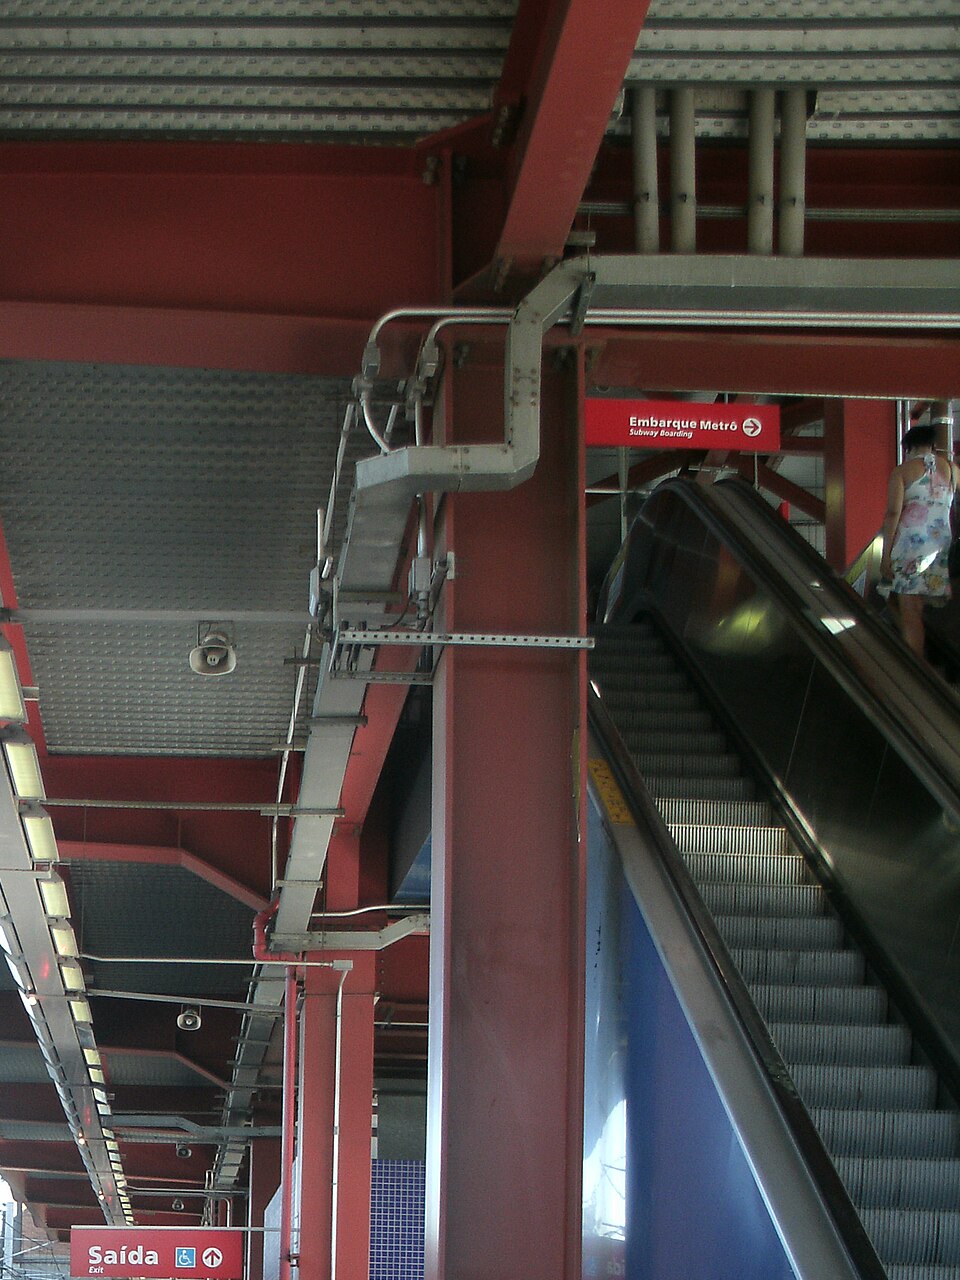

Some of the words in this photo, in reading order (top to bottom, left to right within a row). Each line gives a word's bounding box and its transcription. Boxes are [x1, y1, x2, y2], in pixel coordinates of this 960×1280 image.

[629, 417, 697, 430] Embarque
[700, 420, 738, 431] Metrô
[629, 429, 658, 438] Subway
[660, 429, 693, 439] Boarding
[88, 1246, 158, 1264] Saída
[88, 1266, 104, 1274] Exit
